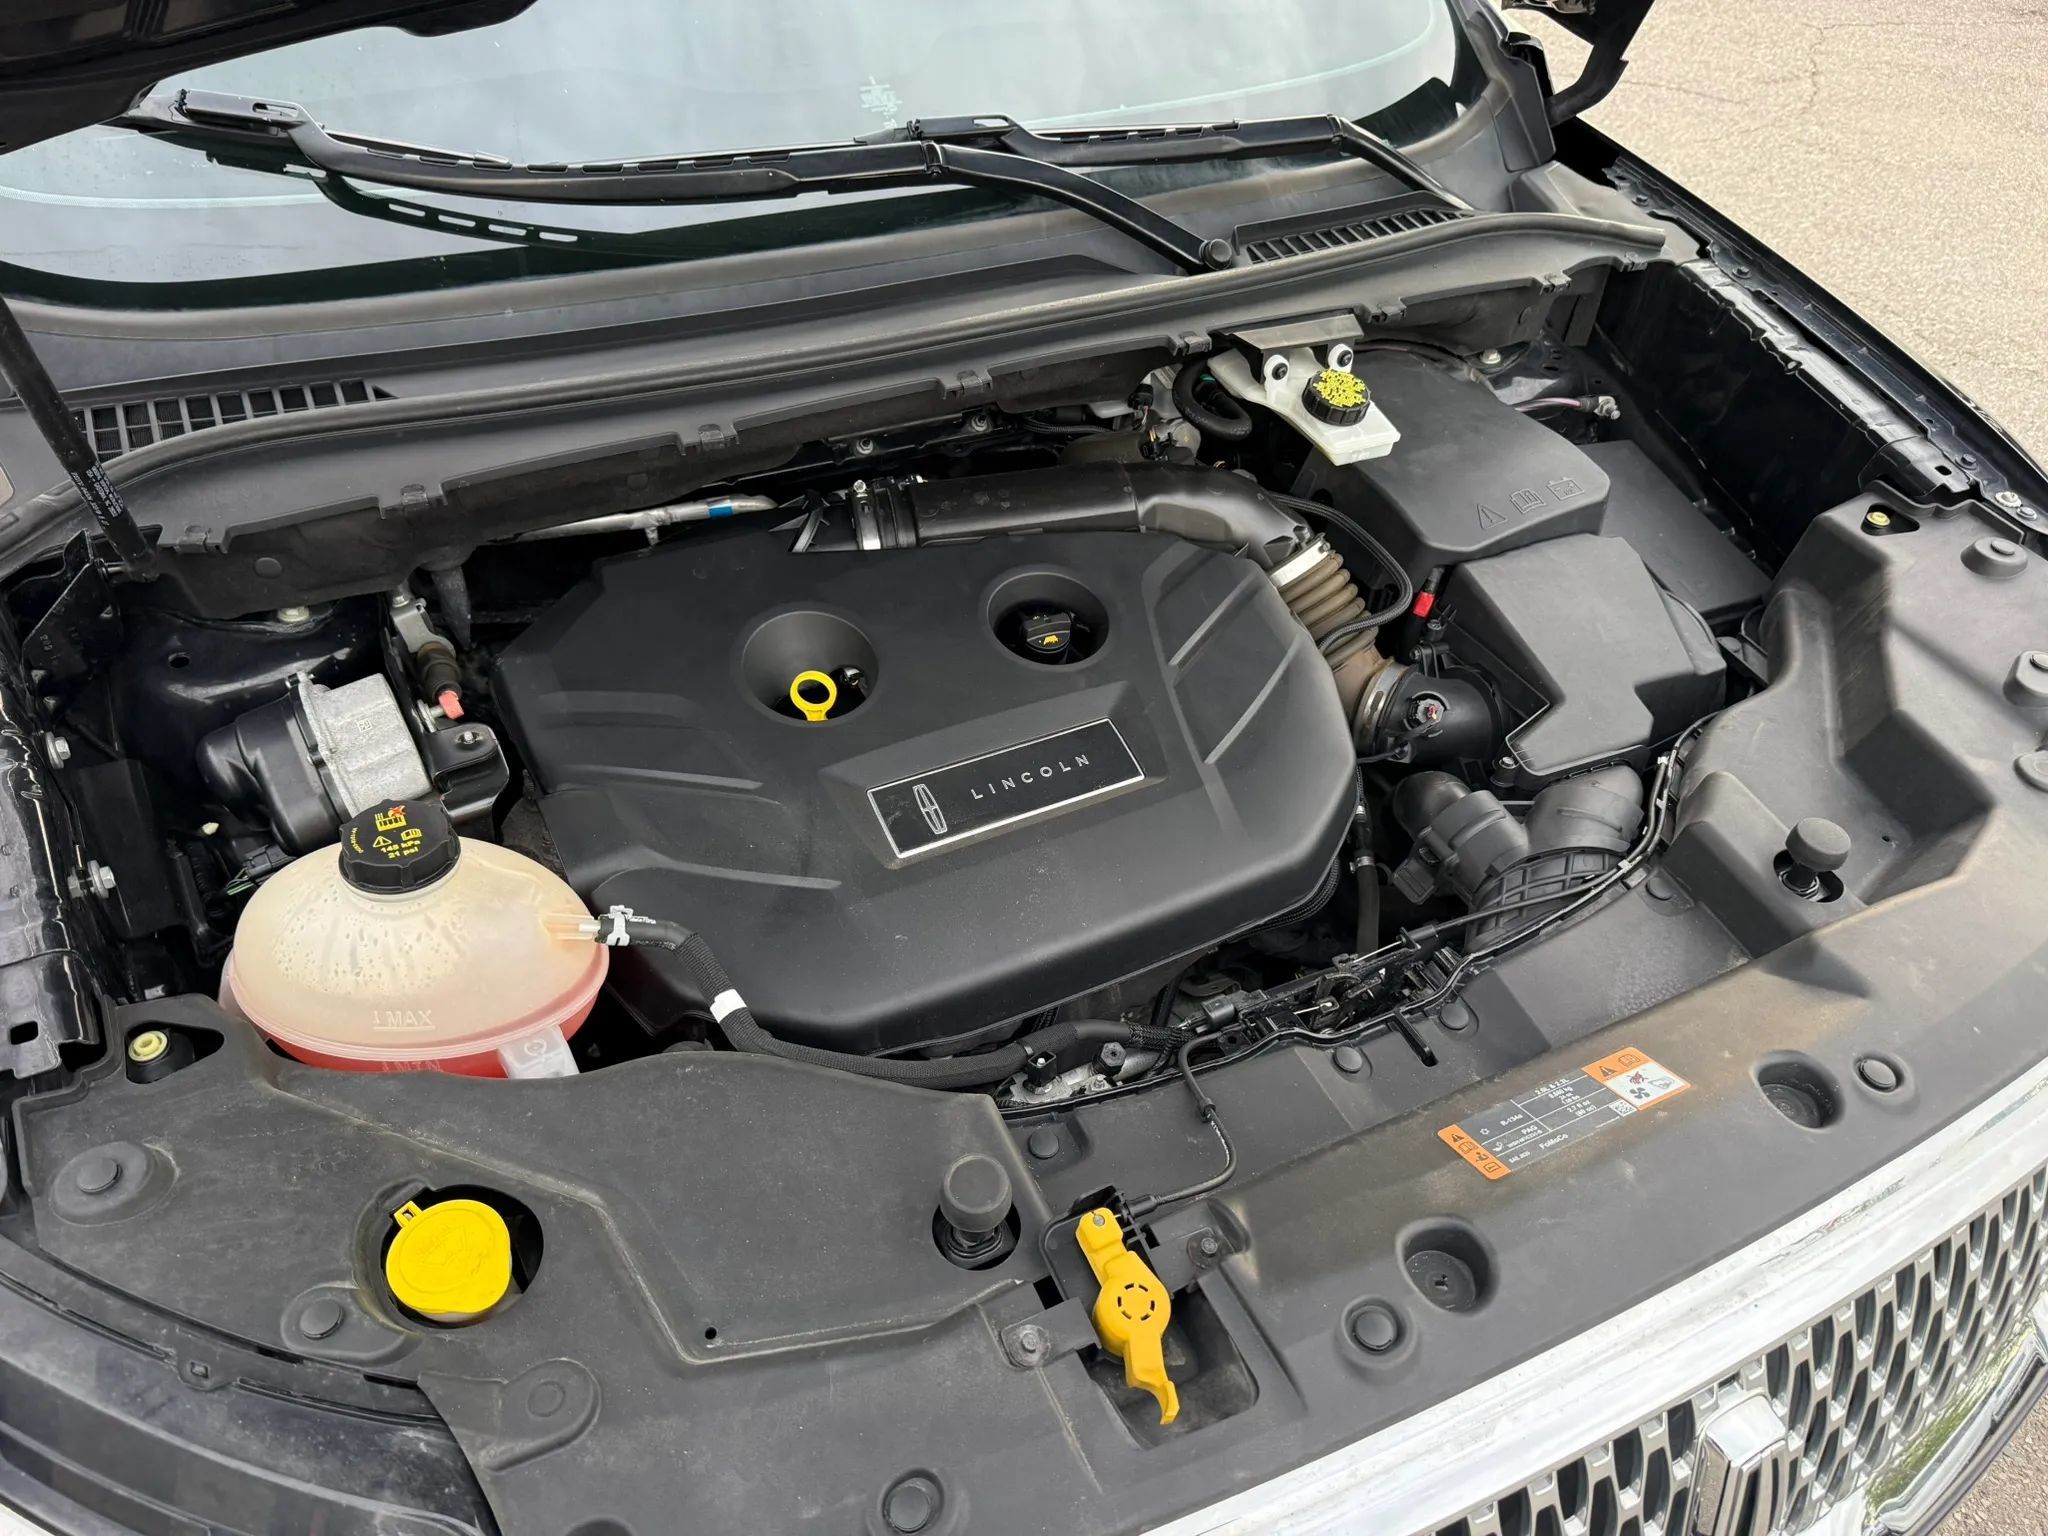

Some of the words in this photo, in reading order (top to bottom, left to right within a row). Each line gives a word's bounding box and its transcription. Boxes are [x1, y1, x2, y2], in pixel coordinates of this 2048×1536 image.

[970, 754, 1090, 800] LINCOLN
[387, 851, 400, 859] 21
[403, 847, 419, 856] psi
[386, 1009, 433, 1026] MAX
[1500, 1114, 1523, 1126] R-134a
[1521, 1124, 1539, 1135] PAG
[1539, 1134, 1569, 1149] FoMoCo
